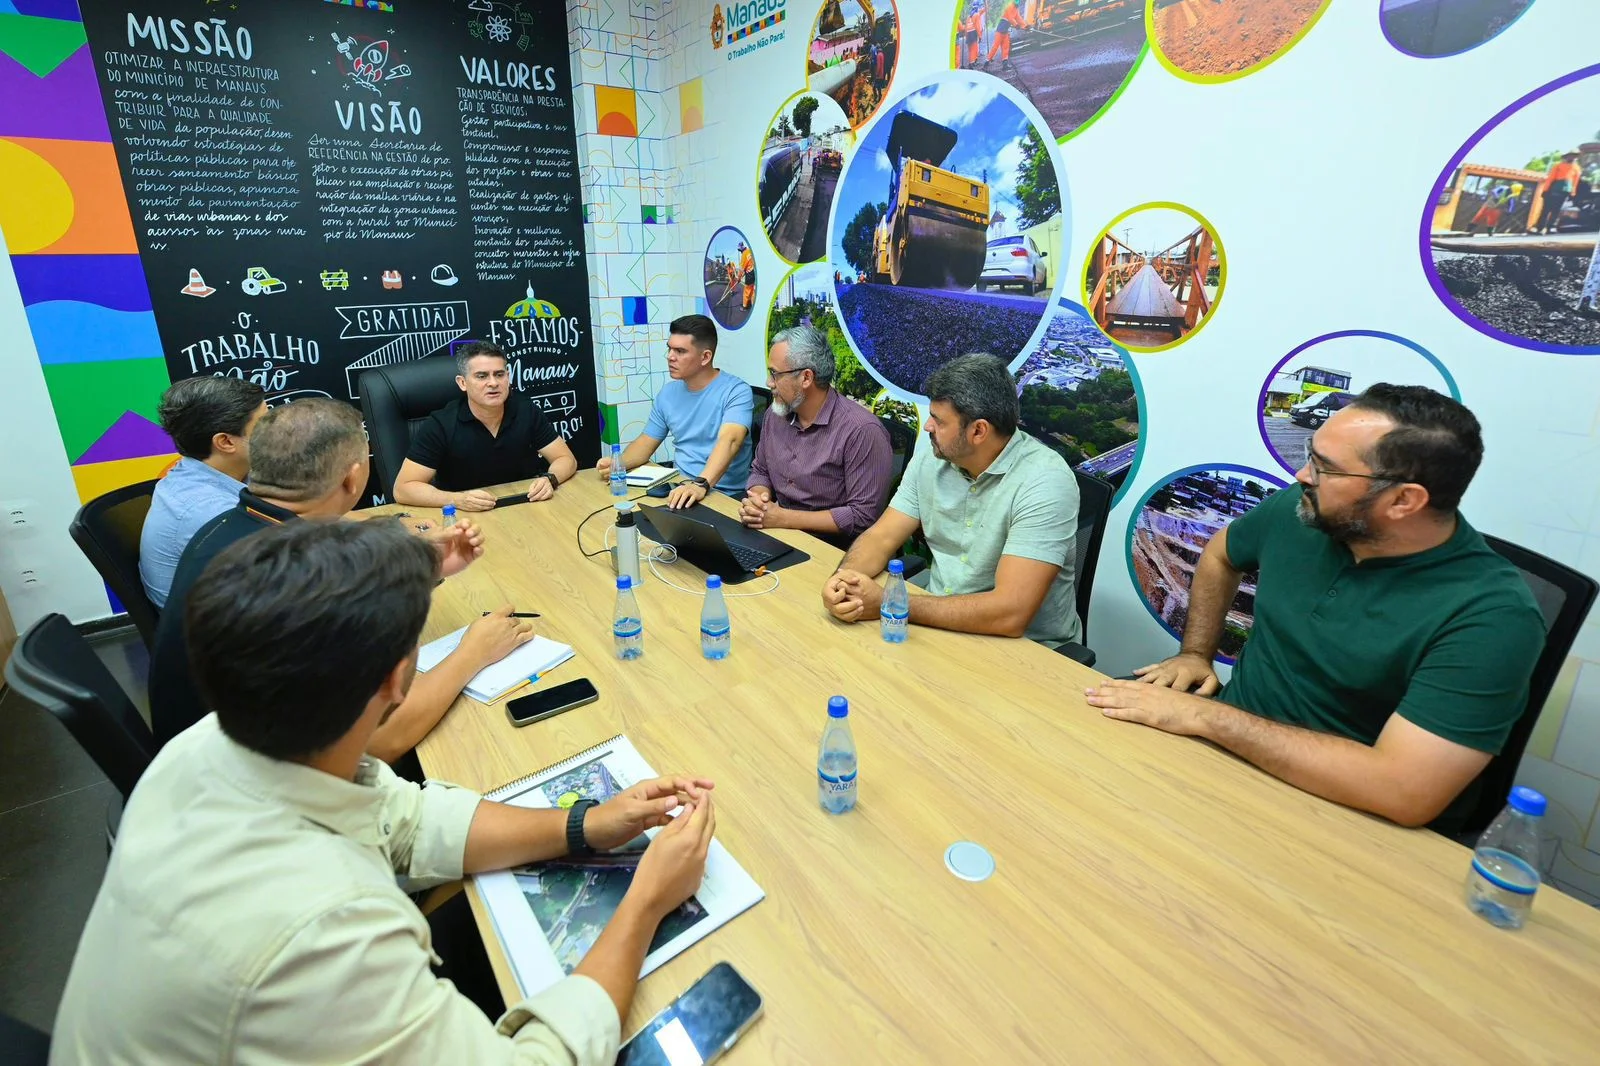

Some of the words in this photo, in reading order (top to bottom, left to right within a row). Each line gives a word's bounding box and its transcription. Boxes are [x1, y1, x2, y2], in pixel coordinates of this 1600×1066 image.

[127, 13, 252, 60] MISSÃO
[733, 44, 755, 58] Trabalho
[757, 38, 768, 48] Não
[770, 30, 785, 44] Para!
[104, 51, 164, 70] OTIMIZAR
[173, 59, 182, 71] A
[186, 60, 279, 80] INFRAESTRUTURA
[460, 55, 555, 92] VALORES
[107, 69, 121, 82] DO
[126, 70, 184, 87] MUNICÍPIO
[195, 78, 209, 90] DE
[216, 79, 266, 94] MANAUS
[115, 89, 148, 99] com
[166, 92, 233, 107] finalidade
[240, 95, 254, 108] de
[456, 87, 519, 103] TRANSPARÊNCIA
[523, 95, 534, 104] NA
[115, 102, 164, 117] TRIBUIR
[173, 106, 200, 118] PARA
[220, 110, 273, 125] QUALIDADE
[459, 99, 472, 112] ÇÃO
[477, 102, 485, 113] DE
[335, 100, 421, 135] VISÃO
[461, 114, 489, 128] Gestão
[494, 118, 542, 130] participativa
[119, 118, 132, 129] DE
[141, 119, 166, 130] VIDA
[175, 123, 191, 133] da
[124, 135, 190, 148] volvendo
[194, 138, 263, 153] estratégias
[269, 141, 283, 153] de
[308, 133, 330, 146] Ser
[369, 138, 427, 151] Secretaria
[430, 142, 443, 152] de
[464, 139, 522, 154] Compromisso
[130, 150, 191, 164] políticas
[195, 151, 249, 166] públicas
[253, 158, 279, 169] para
[308, 147, 368, 161] REFERÊNCIA
[372, 151, 383, 162] NA
[386, 152, 417, 163] GESTÃO
[421, 154, 431, 163] de
[465, 152, 499, 163] bilidade
[536, 159, 572, 168] execução
[131, 167, 164, 176] recer
[168, 165, 253, 179] saneamento
[312, 163, 338, 176] jetos
[351, 167, 399, 176] execução
[399, 166, 409, 175] de
[411, 168, 438, 177] obras
[466, 166, 480, 174] dos
[484, 167, 517, 179] projetos
[531, 169, 554, 178] obras
[136, 180, 176, 192] obras
[316, 176, 345, 186] blicas
[365, 178, 414, 191] ampliação
[138, 196, 182, 207] mento
[188, 195, 204, 207] da
[316, 190, 349, 200] ração
[349, 190, 362, 200] da
[364, 191, 400, 201] malha
[402, 192, 433, 202] viária
[469, 189, 517, 202] Realização
[521, 190, 530, 200] de
[533, 192, 560, 204] gastos
[145, 210, 160, 221] de
[164, 211, 193, 221] vias
[197, 211, 251, 221] urbanas
[265, 211, 288, 222] dos
[320, 203, 377, 216] integração
[379, 204, 391, 214] da
[394, 207, 420, 218] zona
[422, 205, 457, 215] urbana
[519, 204, 551, 213] execução
[555, 204, 569, 212] dos
[357, 216, 390, 226] rural
[147, 226, 199, 237] acessos
[233, 227, 272, 242] zonas
[324, 230, 343, 242] pio
[345, 229, 357, 239] de
[474, 225, 513, 236] Inovação
[524, 226, 561, 235] melhoria
[534, 238, 565, 248] padrões
[475, 250, 510, 258] conceitos
[476, 260, 509, 269] estrutura
[525, 260, 564, 268] Município
[238, 312, 251, 328] O
[358, 306, 455, 332] GRATIDÃO
[181, 333, 320, 373] TRABALHO
[507, 346, 561, 359] CONSTRUINDO
[561, 396, 568, 406] O
